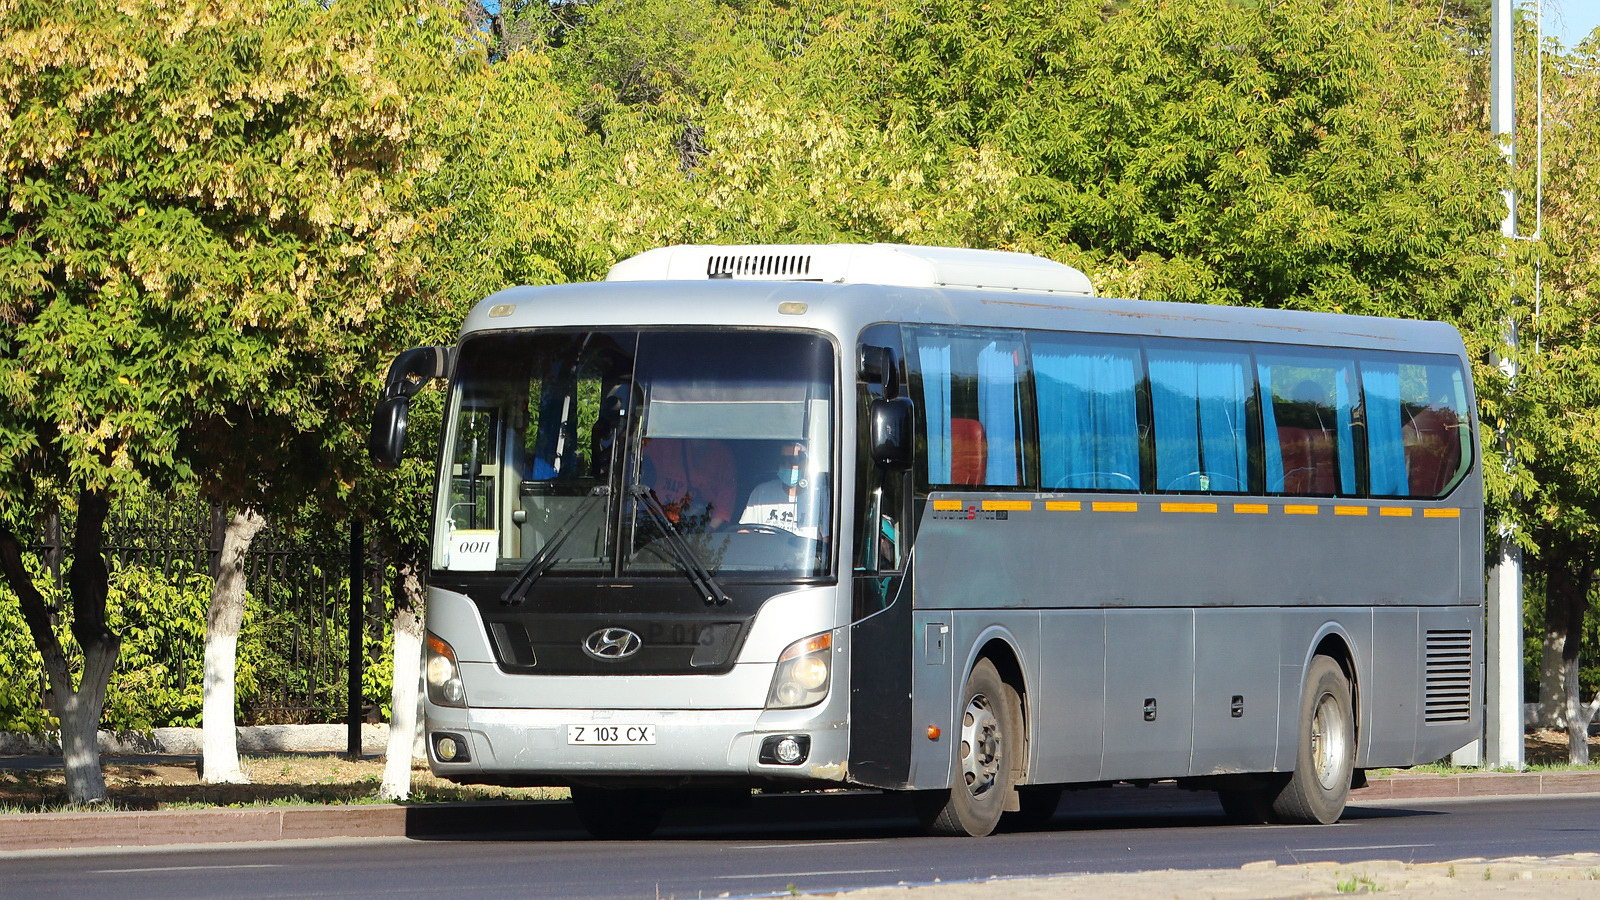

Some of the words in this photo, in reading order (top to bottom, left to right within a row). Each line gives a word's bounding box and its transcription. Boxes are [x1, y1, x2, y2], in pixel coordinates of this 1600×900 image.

[574, 727, 585, 742] Z
[594, 727, 618, 742] 103
[626, 727, 648, 742] CX
